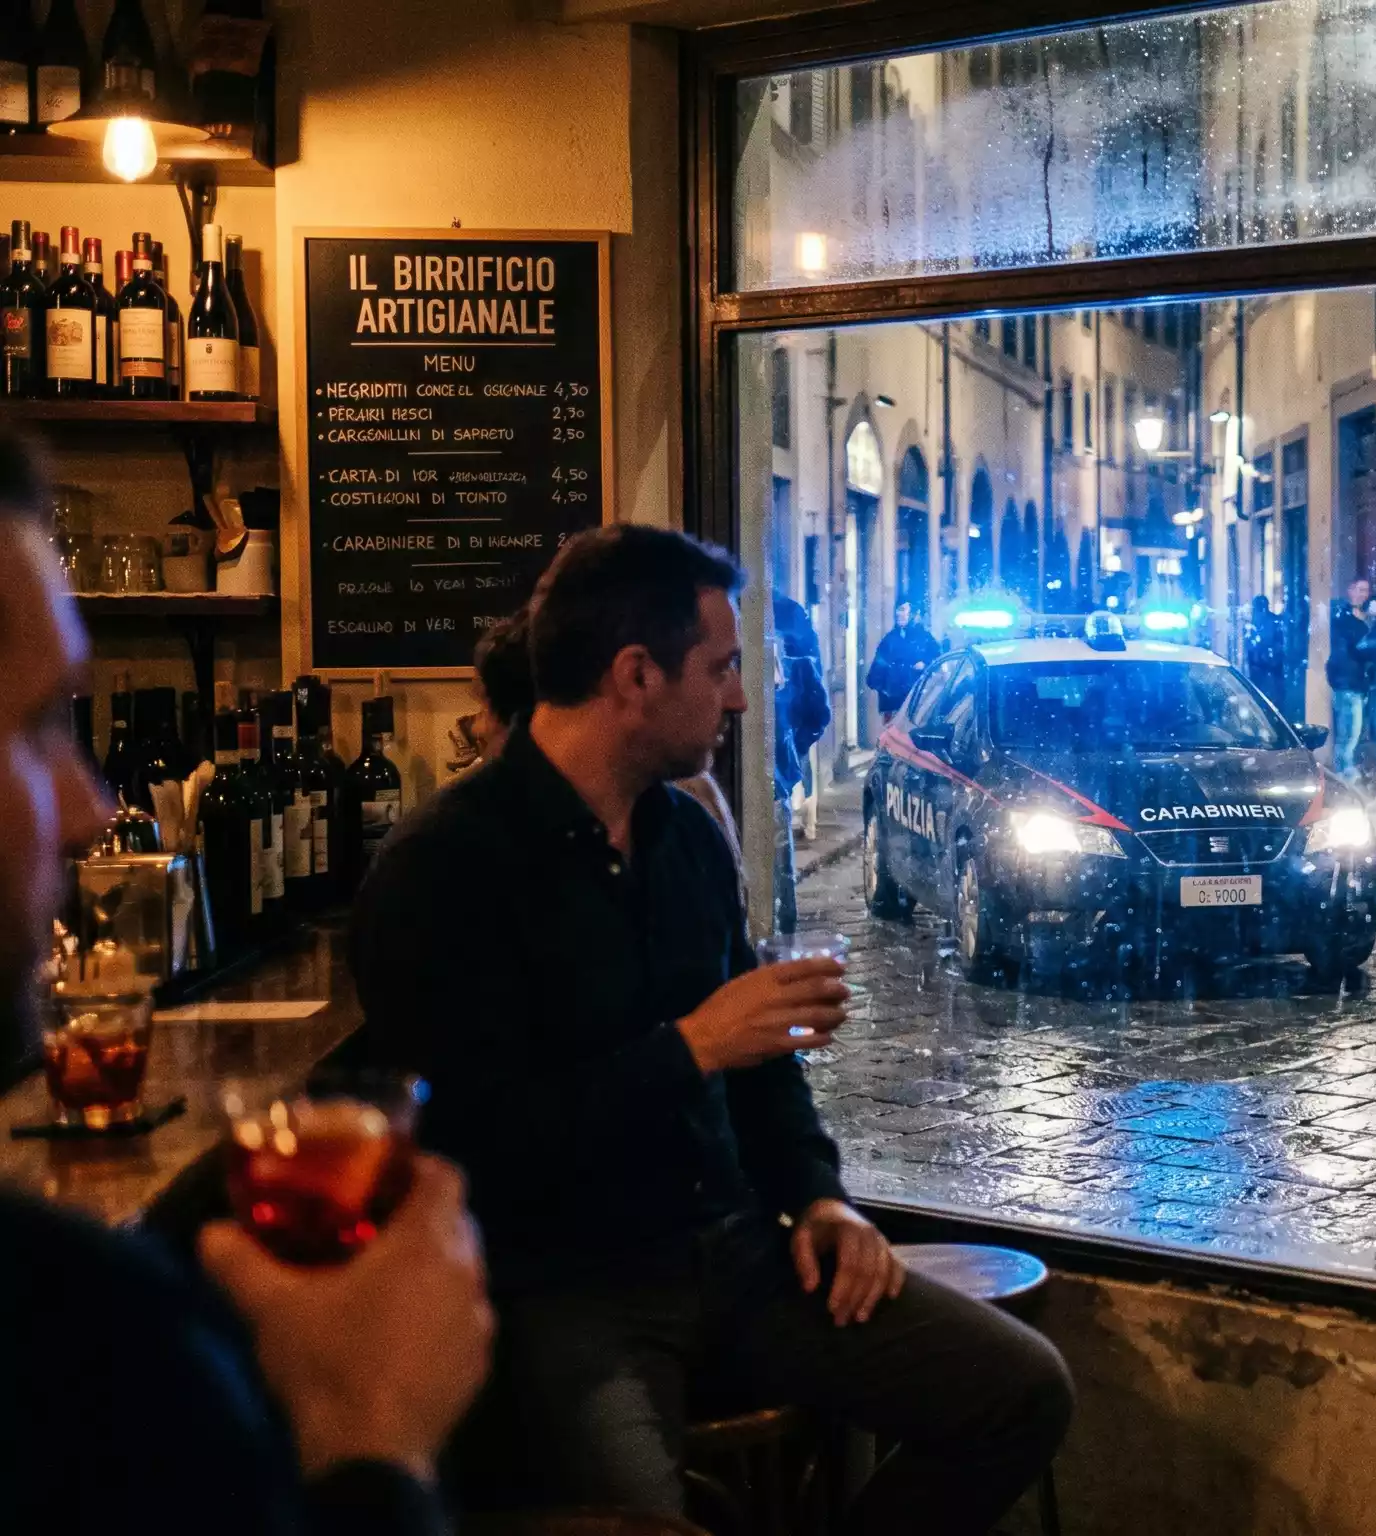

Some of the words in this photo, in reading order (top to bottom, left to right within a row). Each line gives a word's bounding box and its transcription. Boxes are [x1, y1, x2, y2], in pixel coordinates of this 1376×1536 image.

[349, 254, 378, 291] IL
[394, 255, 555, 292] BIRRIFICIO
[356, 298, 555, 334] ARTIGIANALE
[424, 355, 475, 372] MENU
[432, 428, 444, 440] DI
[553, 427, 585, 443] 2,50
[551, 467, 588, 484] 4,50
[432, 492, 445, 504] DI
[333, 535, 435, 551] CARABINIERE
[447, 536, 460, 549] DI
[886, 781, 936, 842] POLIZIA
[1140, 804, 1286, 822] CARABINIERI
